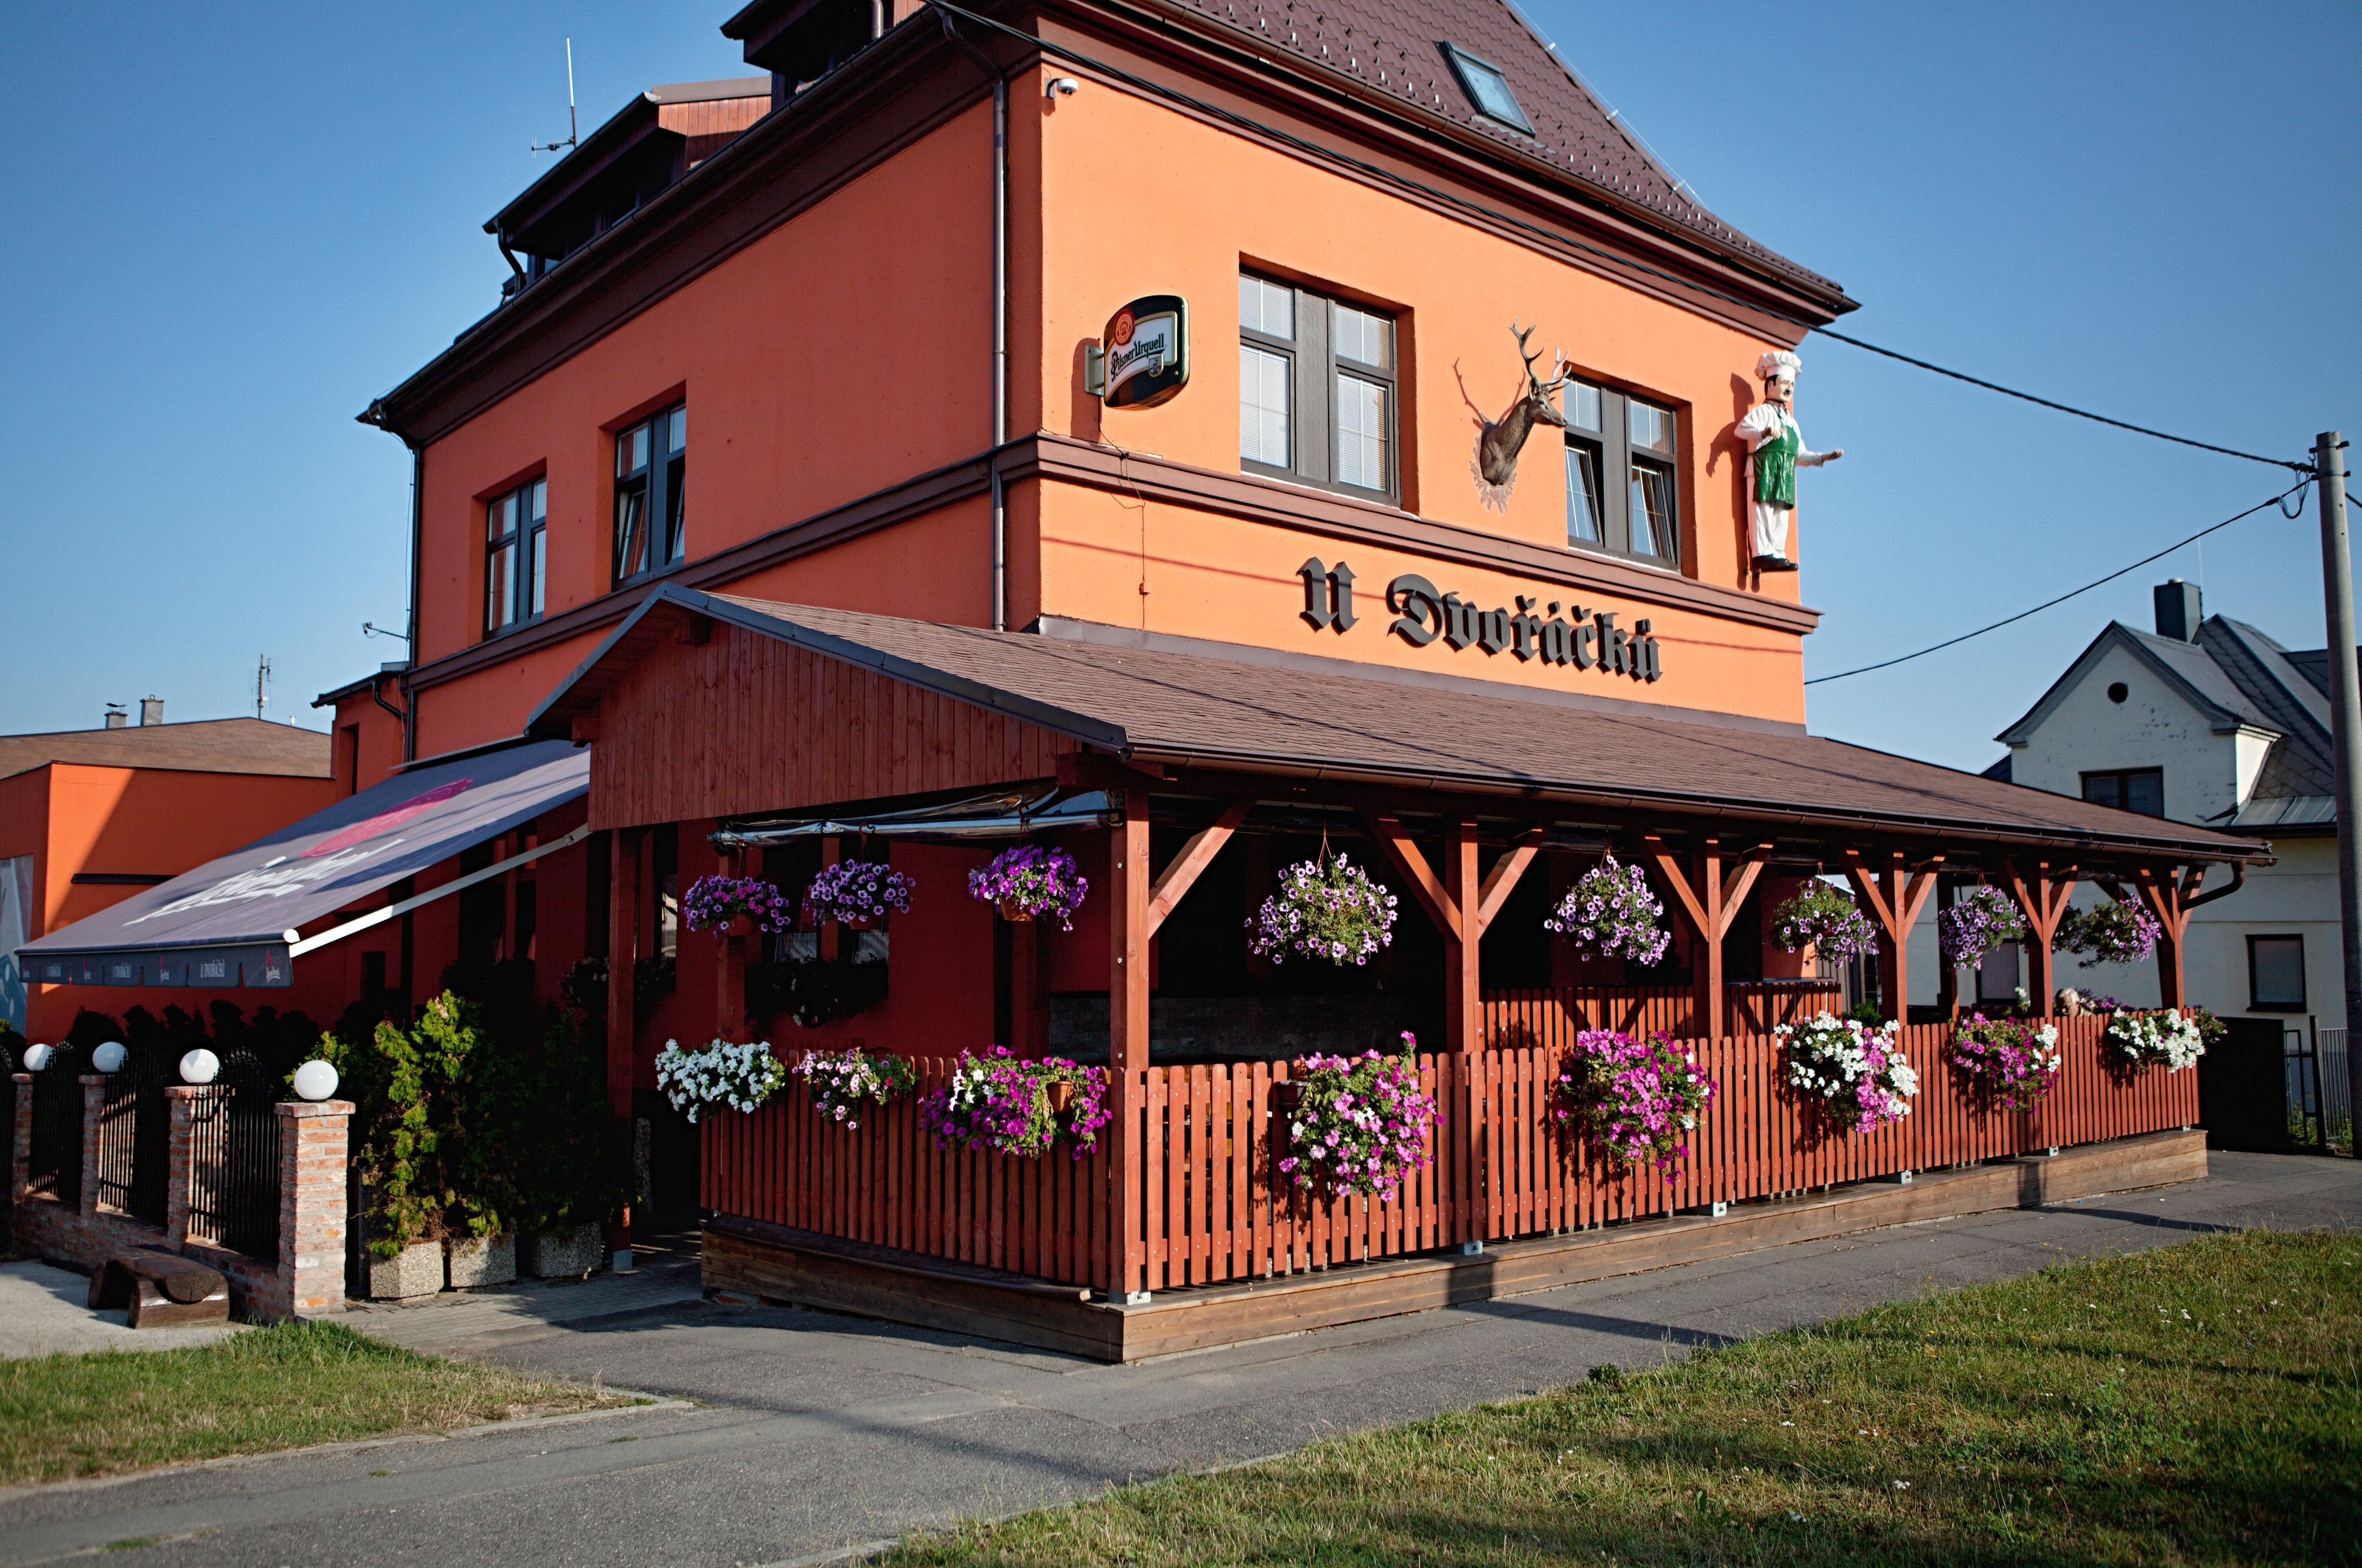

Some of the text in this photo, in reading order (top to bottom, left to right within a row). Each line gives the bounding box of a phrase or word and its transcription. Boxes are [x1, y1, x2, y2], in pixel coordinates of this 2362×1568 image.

[1111, 333, 1165, 382] Pilsner Urquell
[1296, 556, 1663, 685] U Dvořáčků
